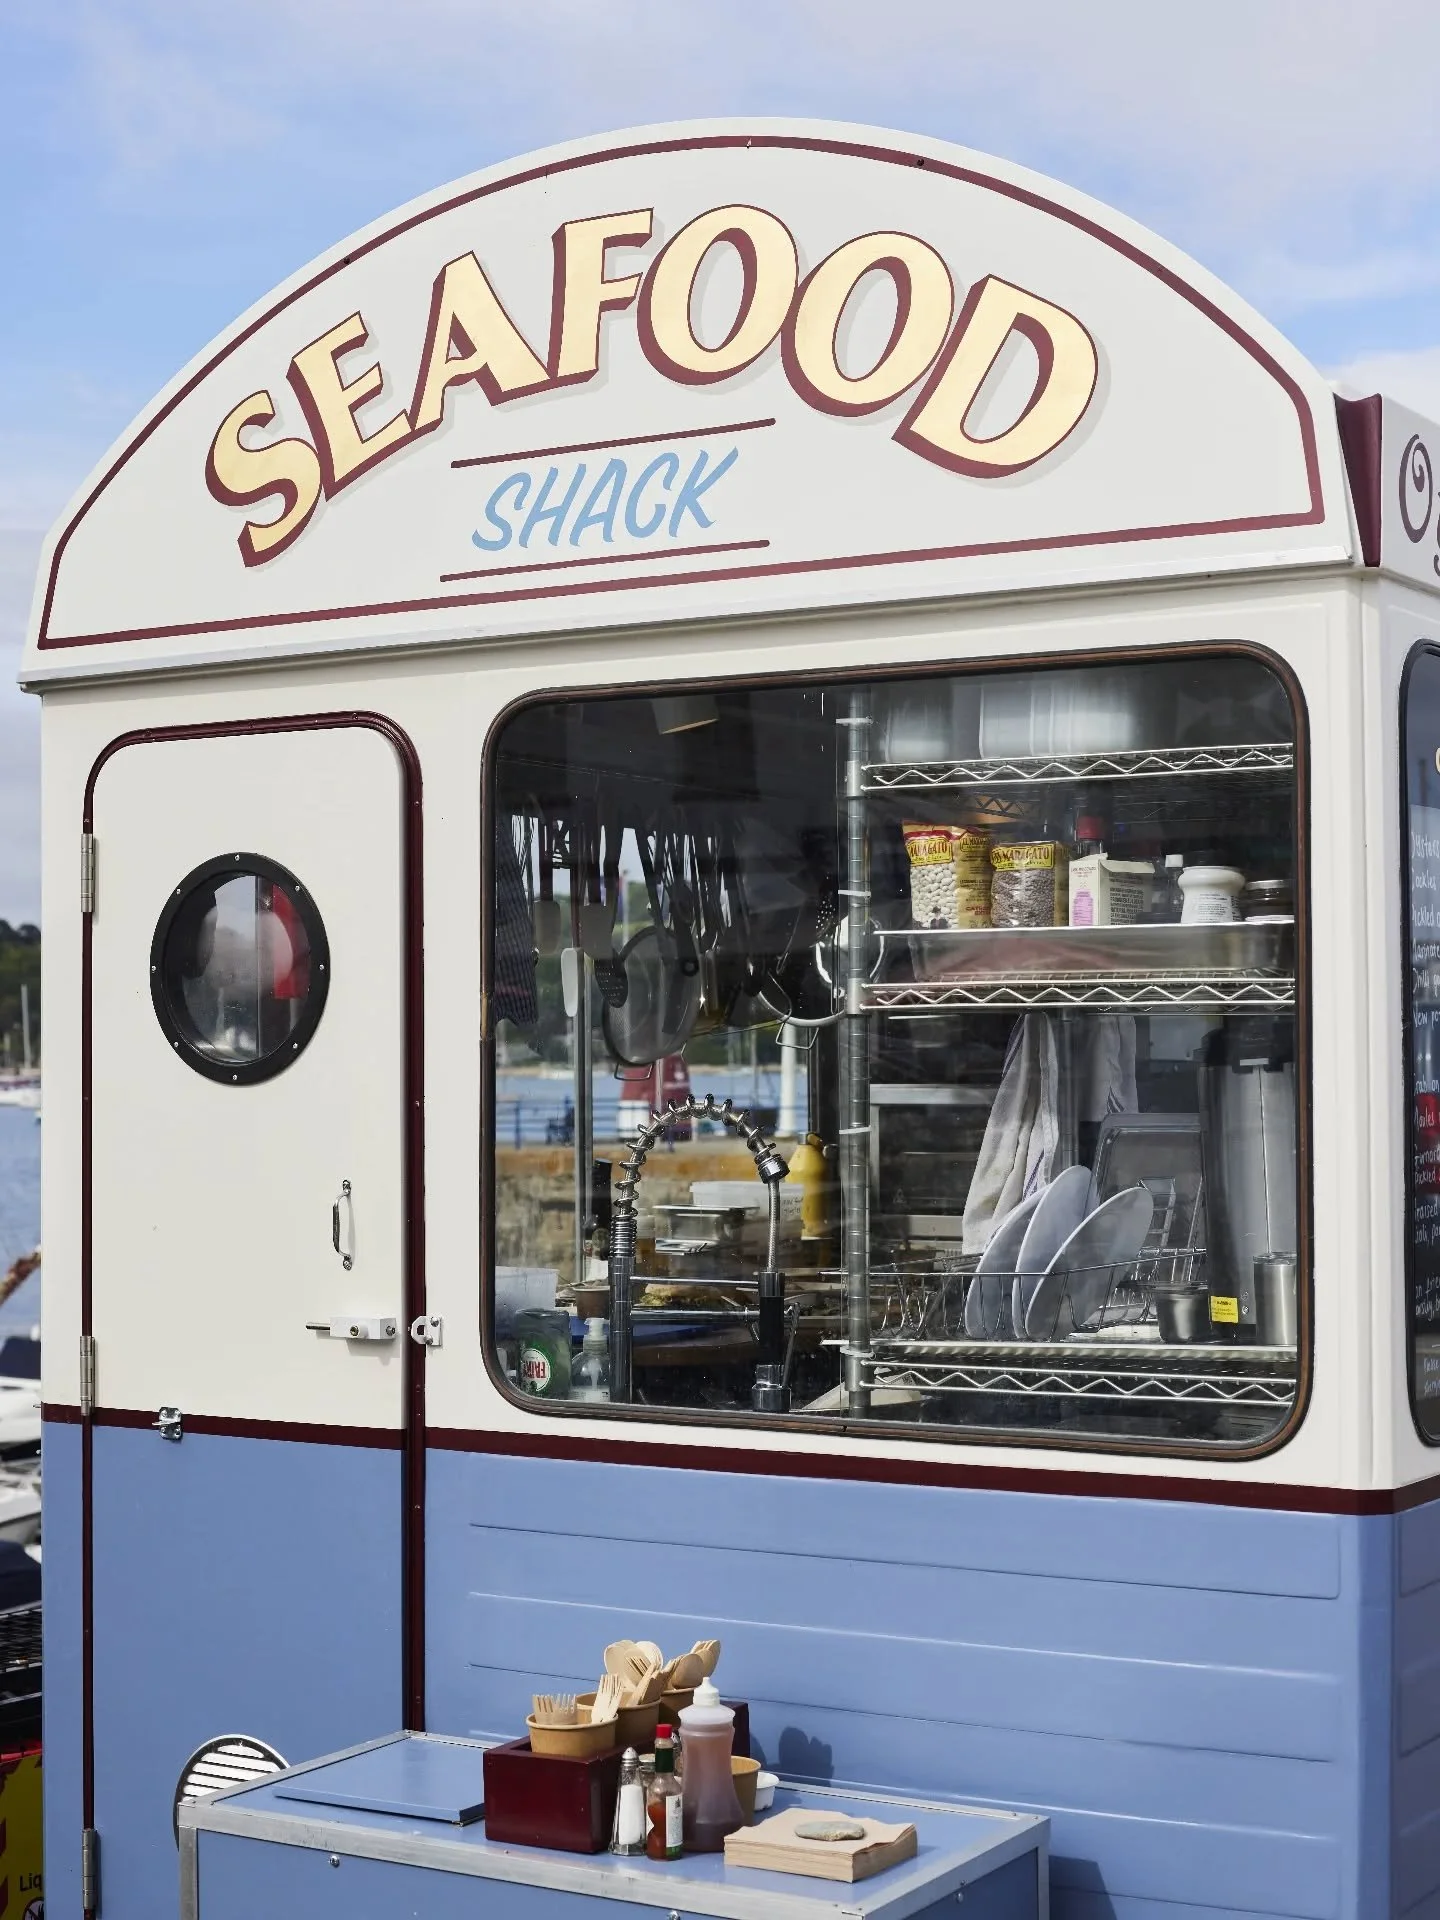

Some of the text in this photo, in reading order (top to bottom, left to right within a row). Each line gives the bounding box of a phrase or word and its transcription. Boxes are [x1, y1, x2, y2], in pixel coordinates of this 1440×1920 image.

[205, 204, 1099, 568] SEAFOOD
[471, 448, 740, 552] SHACK
[1399, 434, 1440, 577] O
